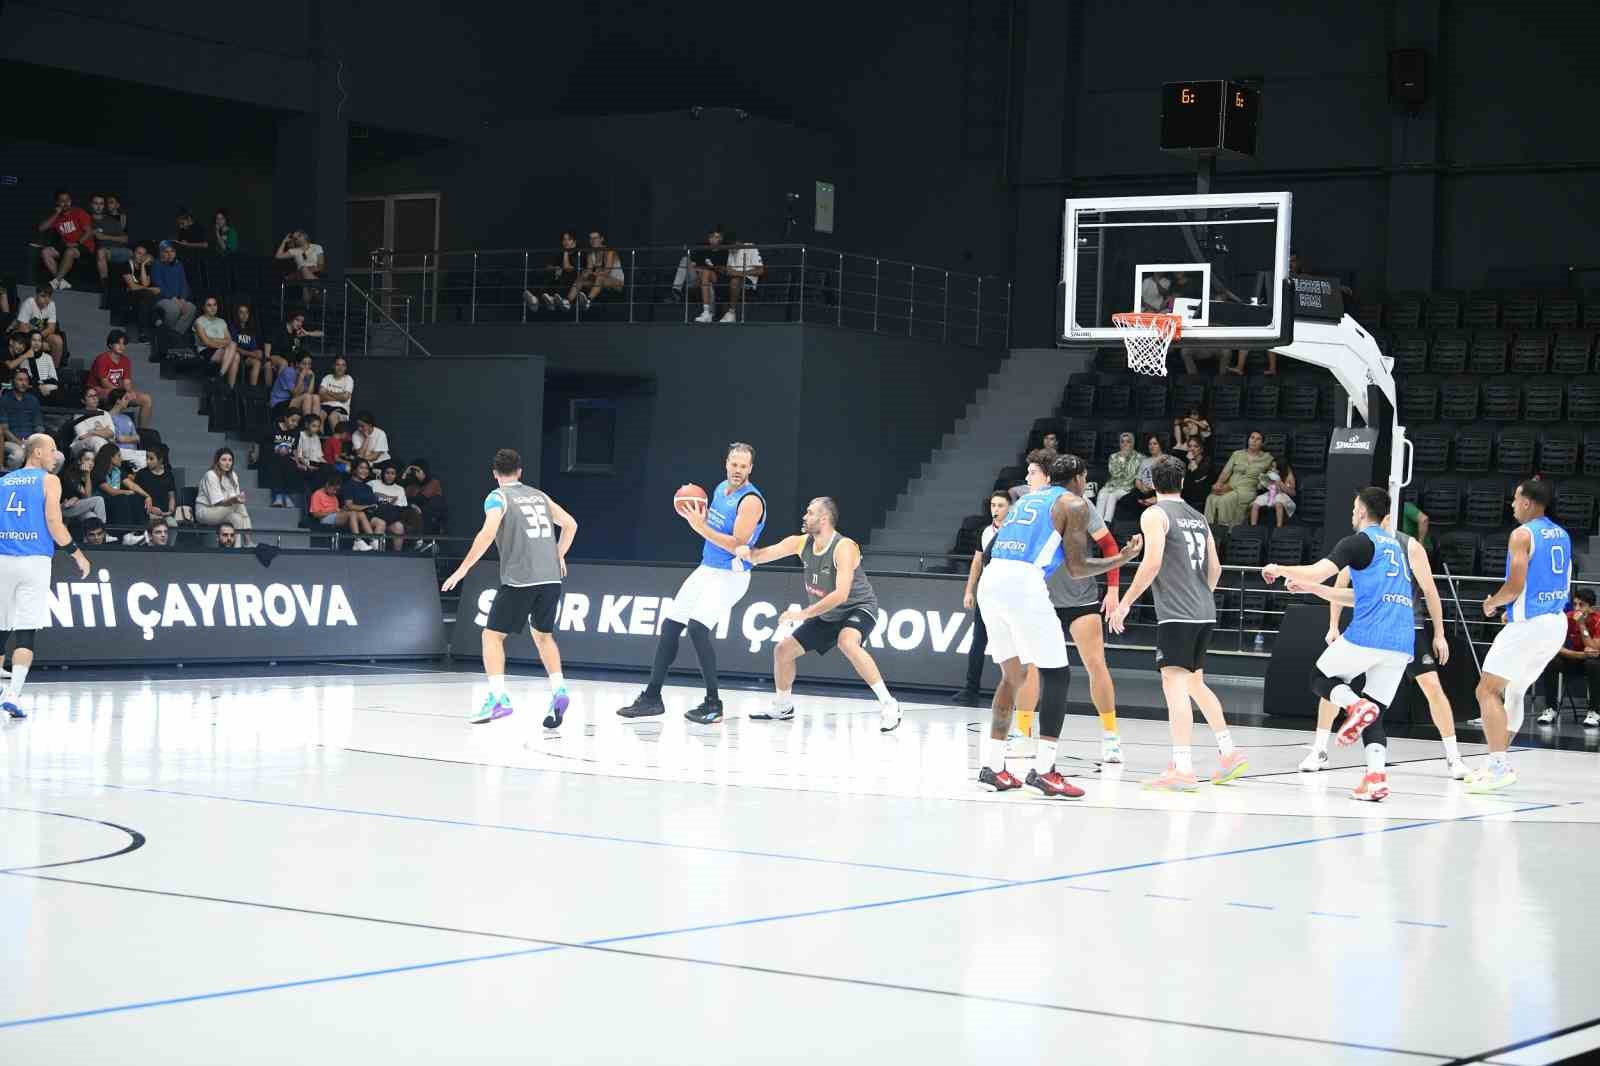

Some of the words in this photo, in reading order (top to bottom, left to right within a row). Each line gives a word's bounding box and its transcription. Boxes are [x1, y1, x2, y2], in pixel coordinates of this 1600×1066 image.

[5, 491, 26, 517] 4
[1550, 545, 1564, 574] 0
[126, 581, 360, 641] ÇAYIROVA
